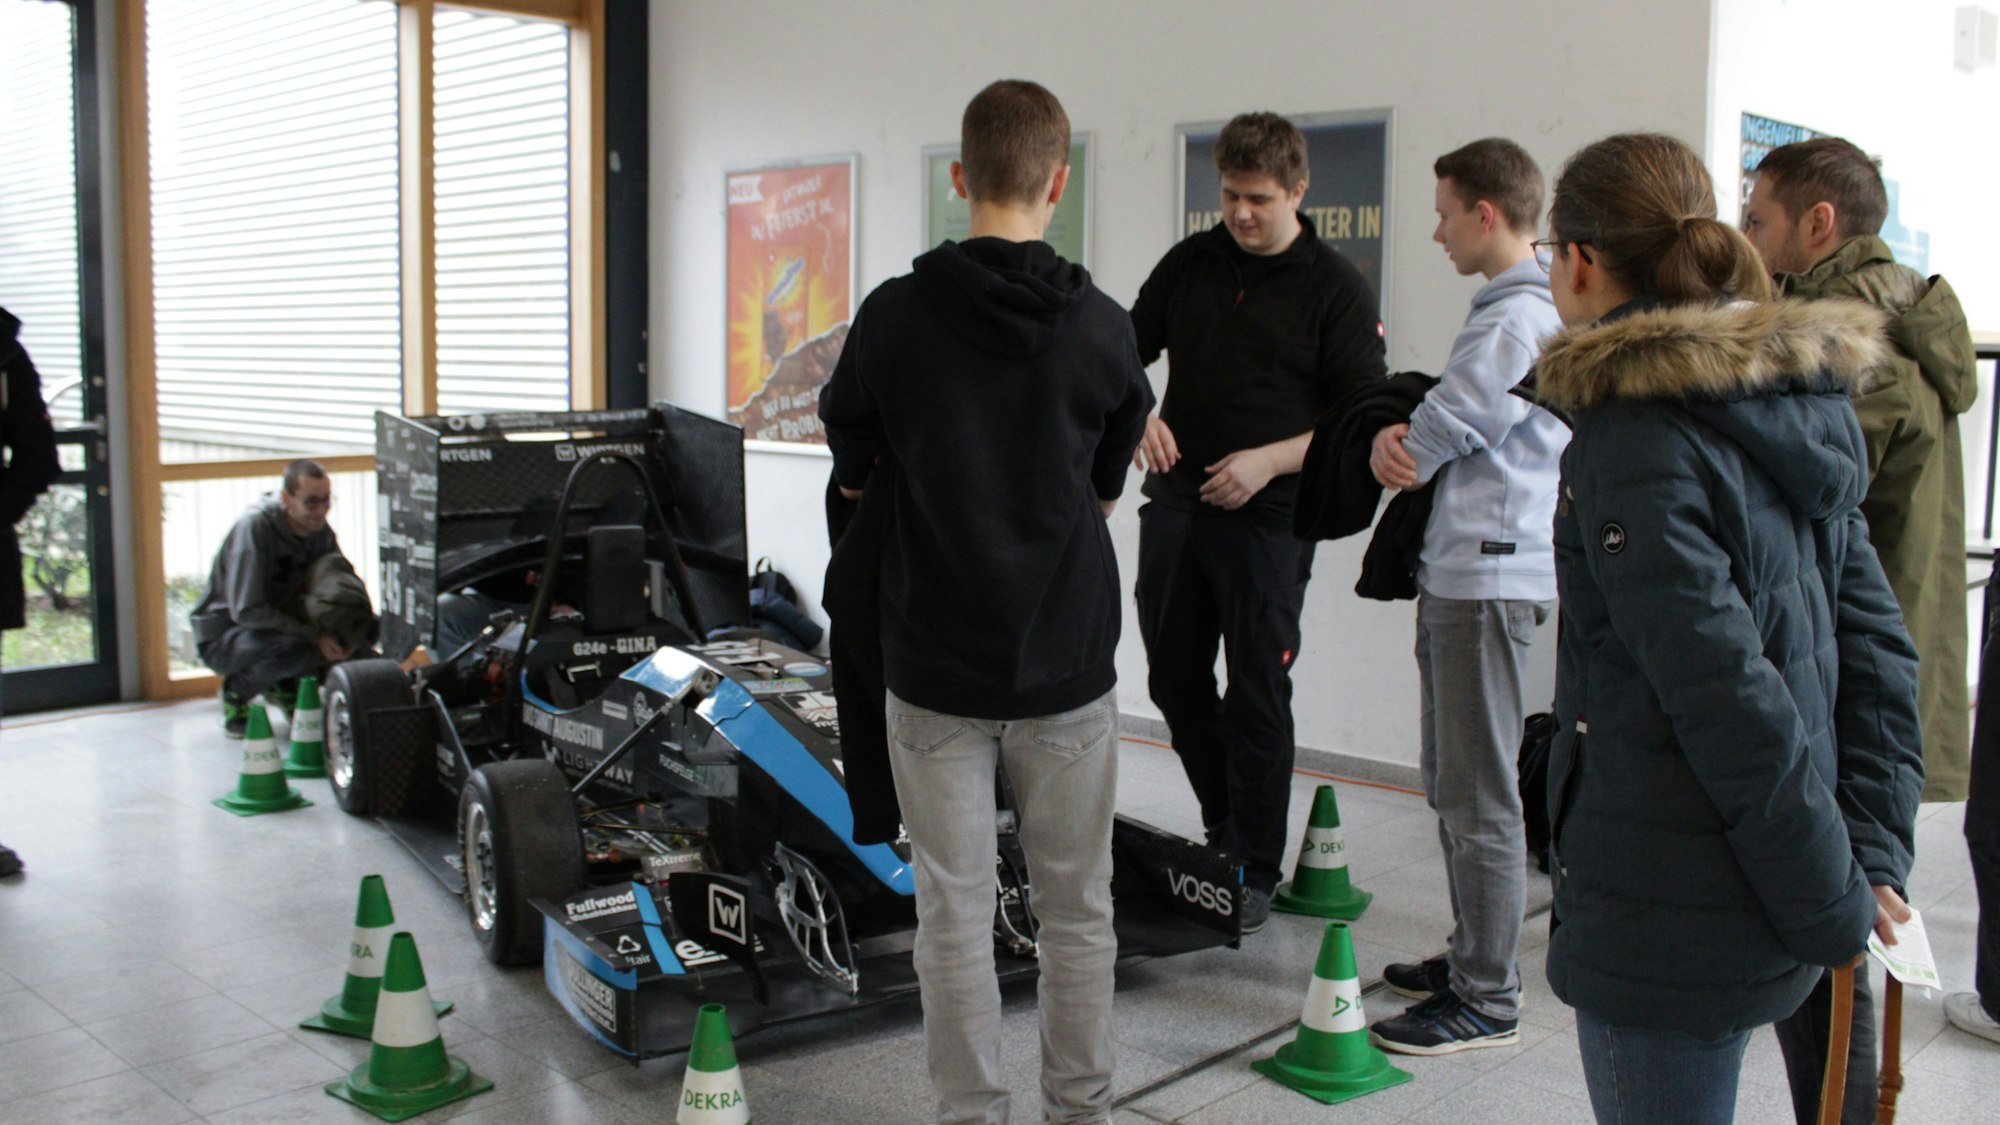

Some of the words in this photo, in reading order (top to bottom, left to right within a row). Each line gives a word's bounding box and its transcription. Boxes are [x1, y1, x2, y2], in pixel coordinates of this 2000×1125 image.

[1743, 114, 1807, 148] INGENIEU
[1358, 205, 1381, 238] IN
[440, 449, 492, 462] RTGEN
[1320, 841, 1344, 854] DEK
[565, 890, 636, 915] Fullwood
[1167, 867, 1233, 917] VOSS
[714, 896, 740, 929] W
[351, 943, 374, 959] RA
[684, 1088, 742, 1110] DEKRA
